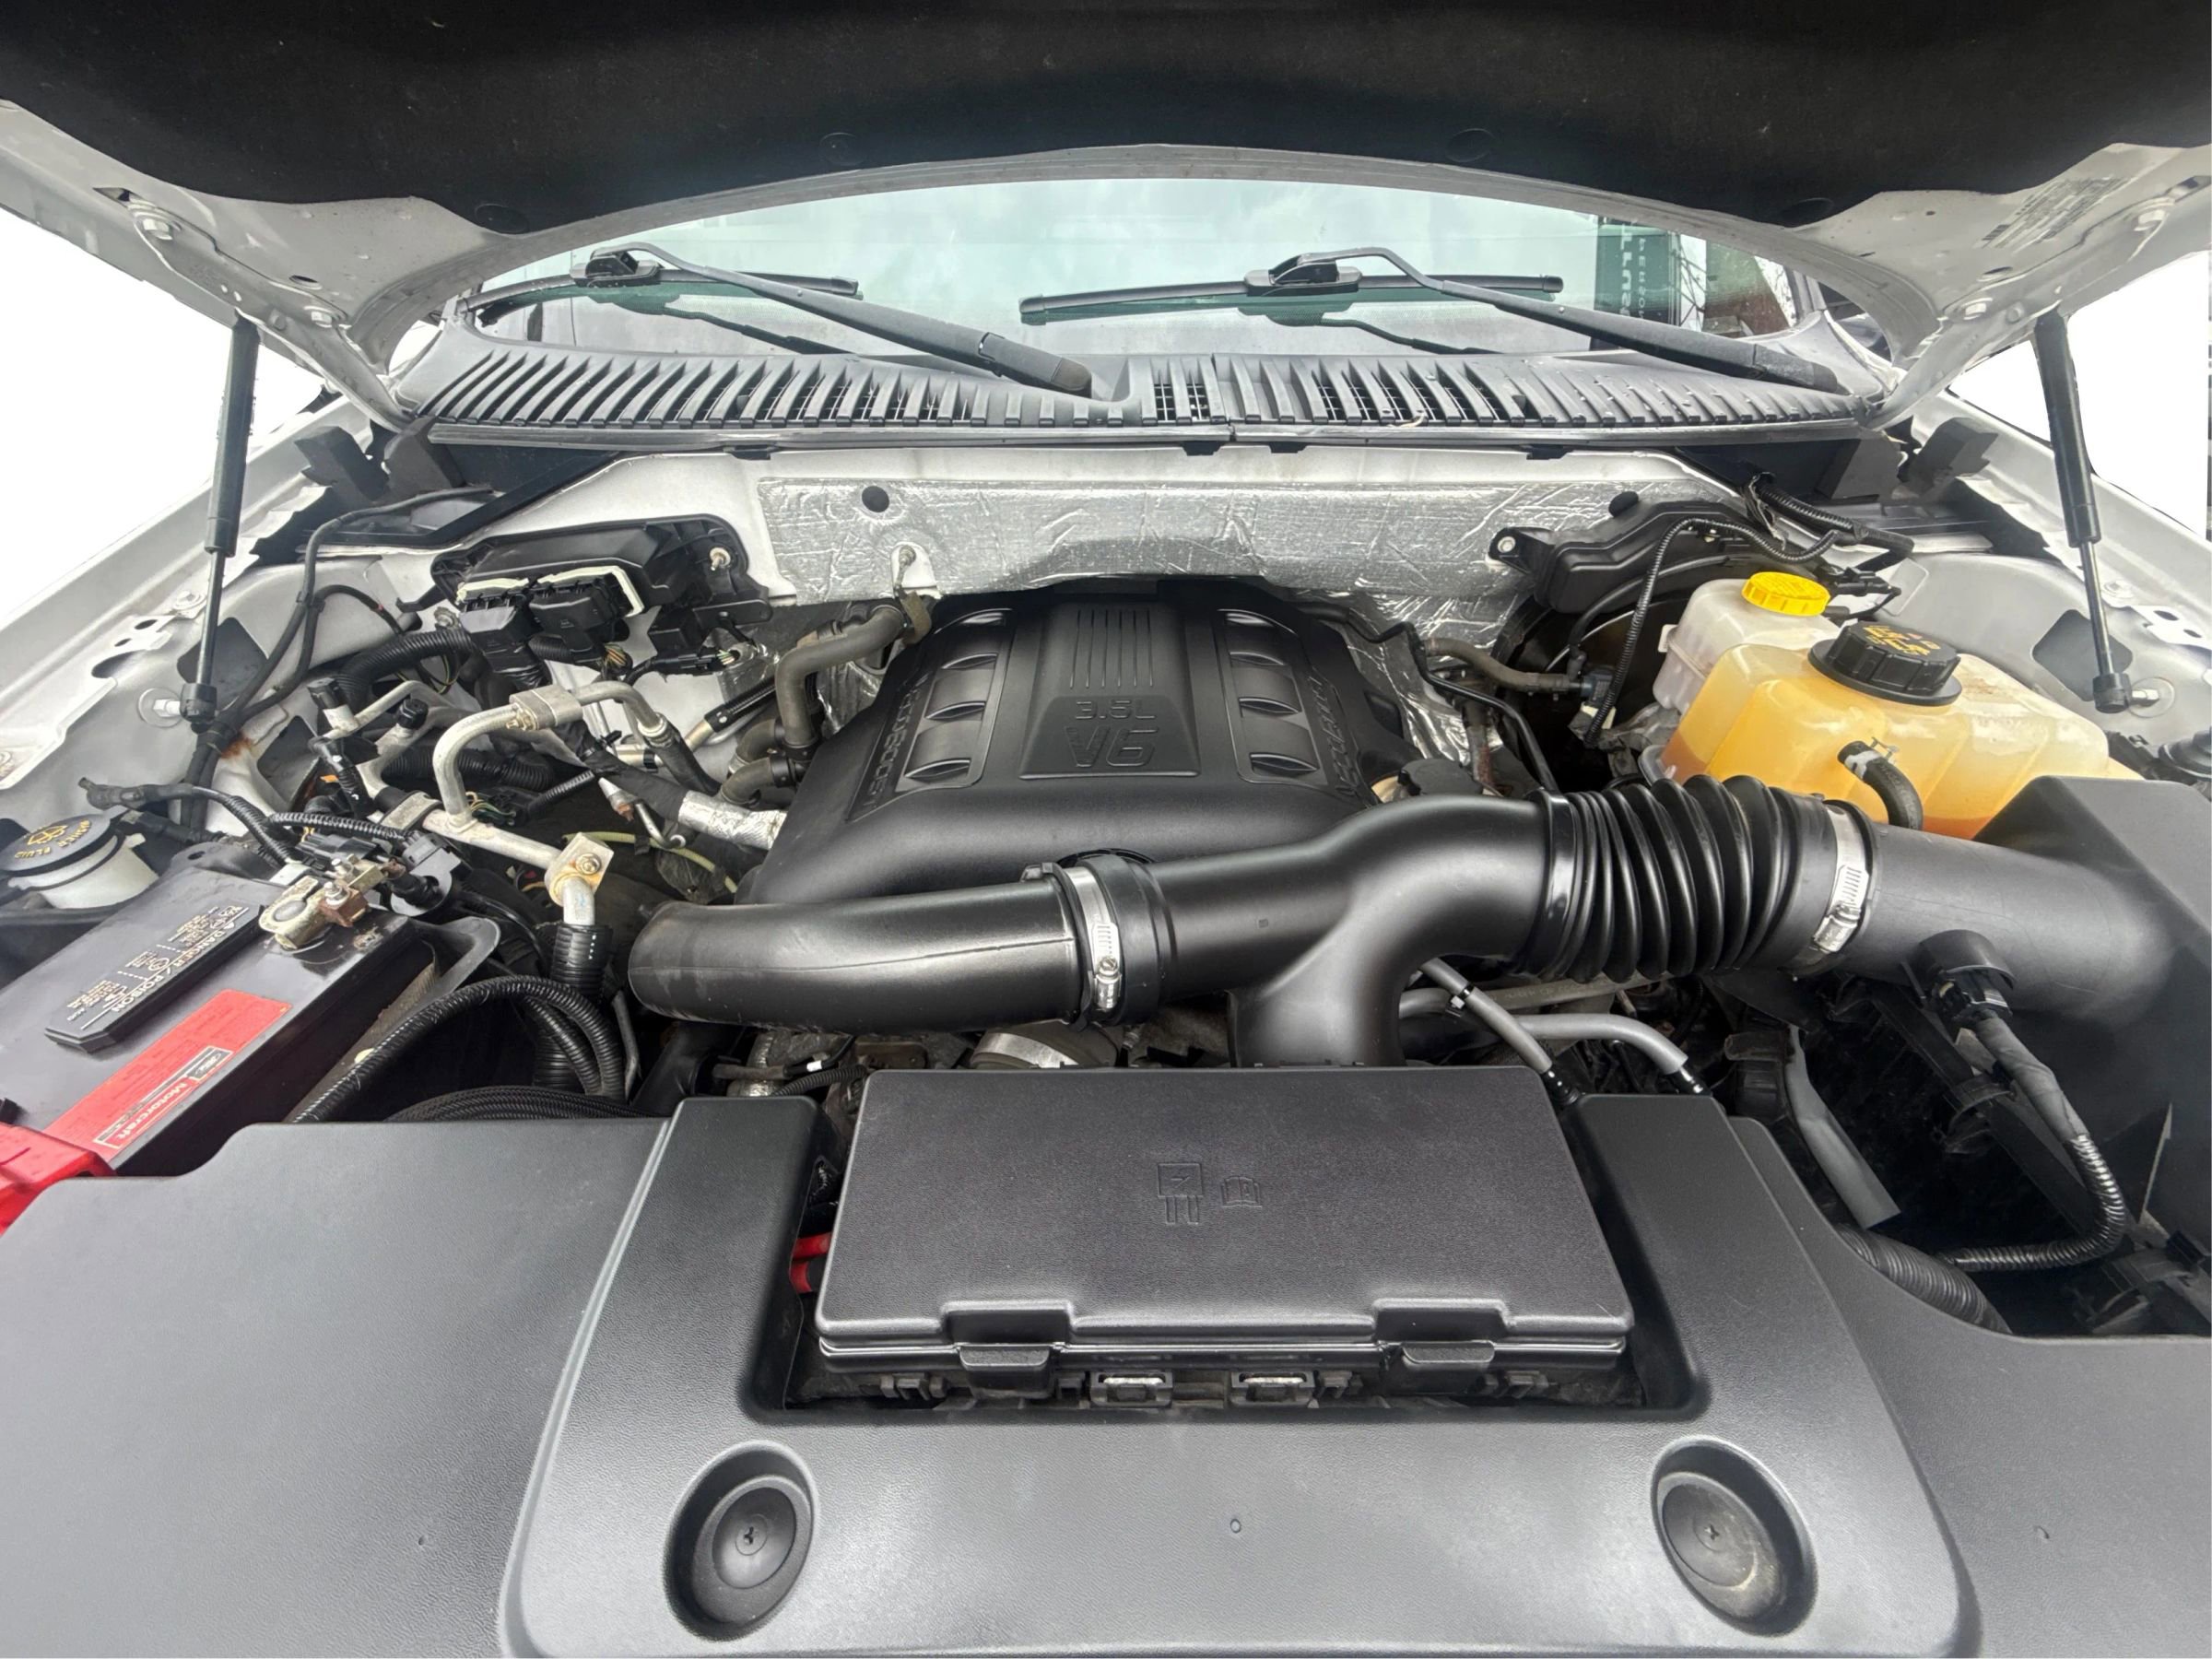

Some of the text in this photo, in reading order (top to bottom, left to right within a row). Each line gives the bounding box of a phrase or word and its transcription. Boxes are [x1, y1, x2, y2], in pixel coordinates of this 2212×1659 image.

[1075, 700, 1157, 721] 3.5L
[1064, 725, 1160, 768] V6
[173, 930, 226, 968] DANGER
[112, 975, 164, 1013] POISON
[117, 1082, 188, 1140] Motorcraft
